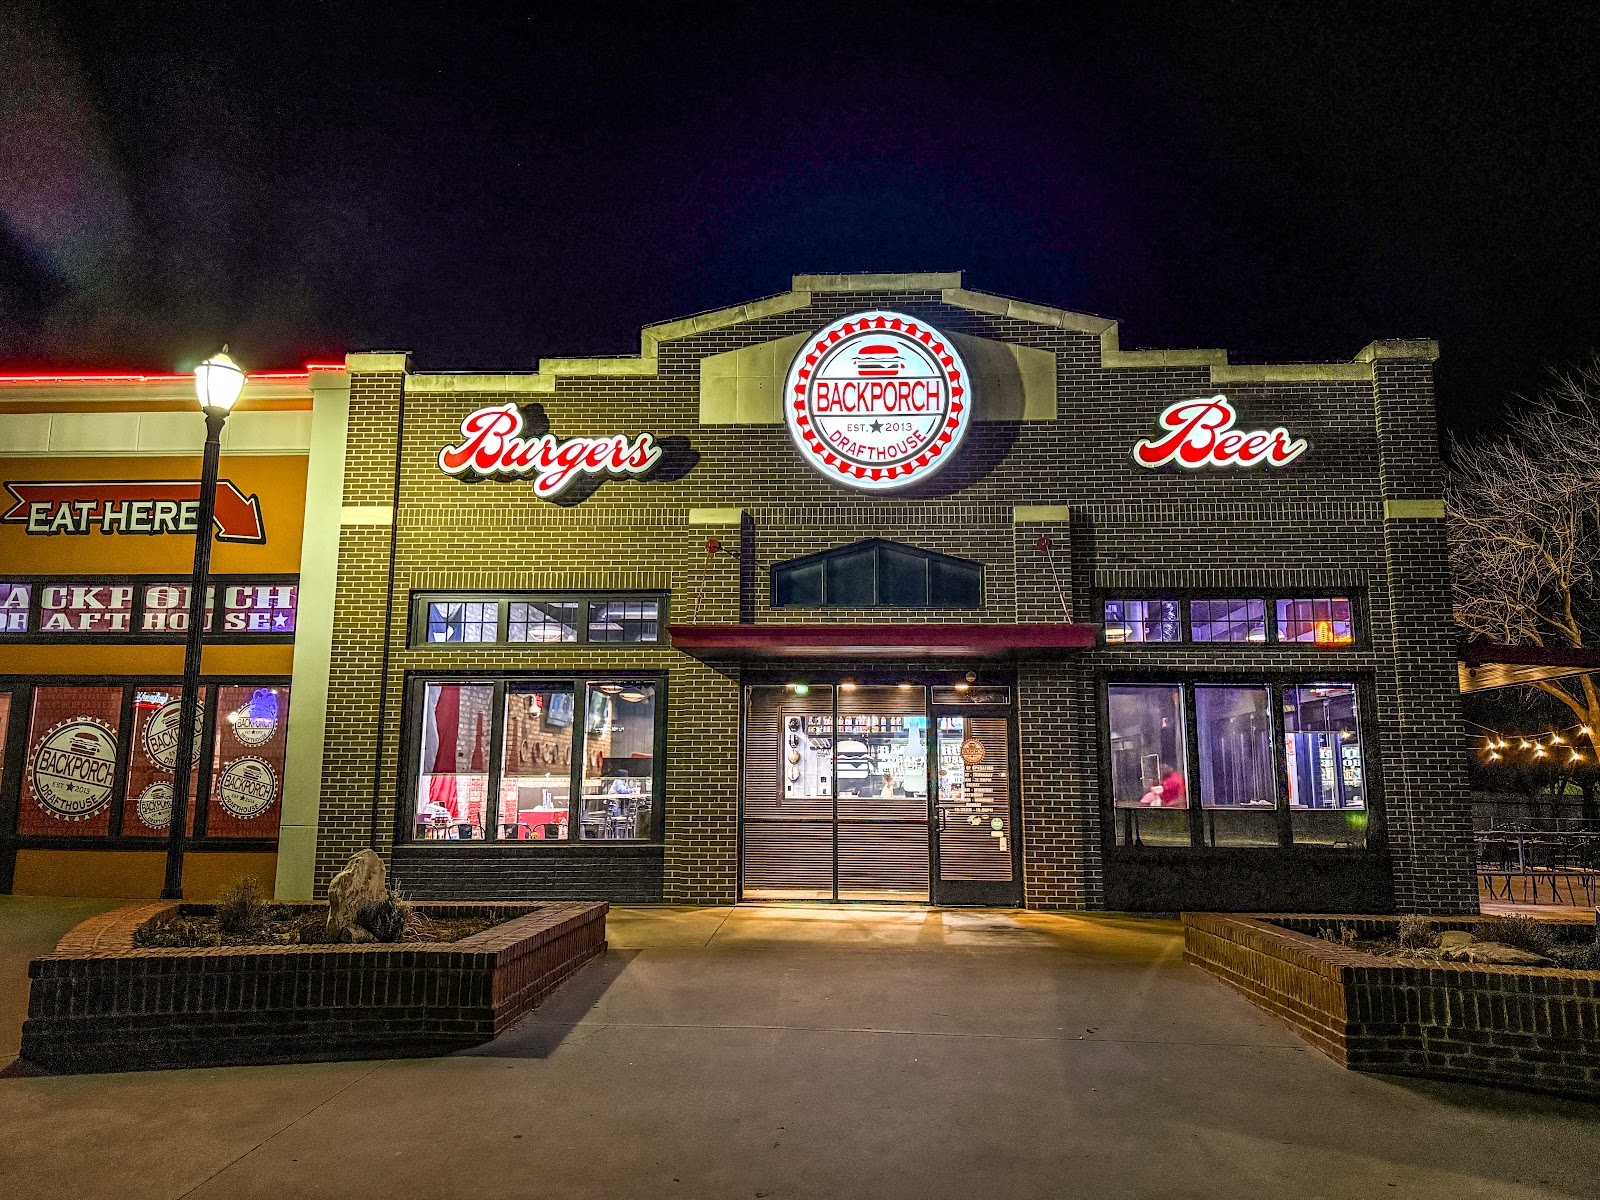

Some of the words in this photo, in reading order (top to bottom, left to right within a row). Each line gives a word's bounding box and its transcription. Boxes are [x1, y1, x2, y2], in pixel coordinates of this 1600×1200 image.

[816, 380, 940, 412] BACKPORCH
[847, 423, 869, 433] EST.
[885, 422, 913, 432] 2013
[1134, 395, 1307, 468] Beer
[438, 402, 663, 499] Burgers
[829, 429, 927, 460] DRAFTHOUSE
[28, 501, 97, 532] EAT
[102, 501, 200, 532] HERE
[39, 750, 114, 785] BACKPORCH
[40, 784, 97, 810] DRAFTHOUSE
[224, 774, 271, 800] BACKPORCH
